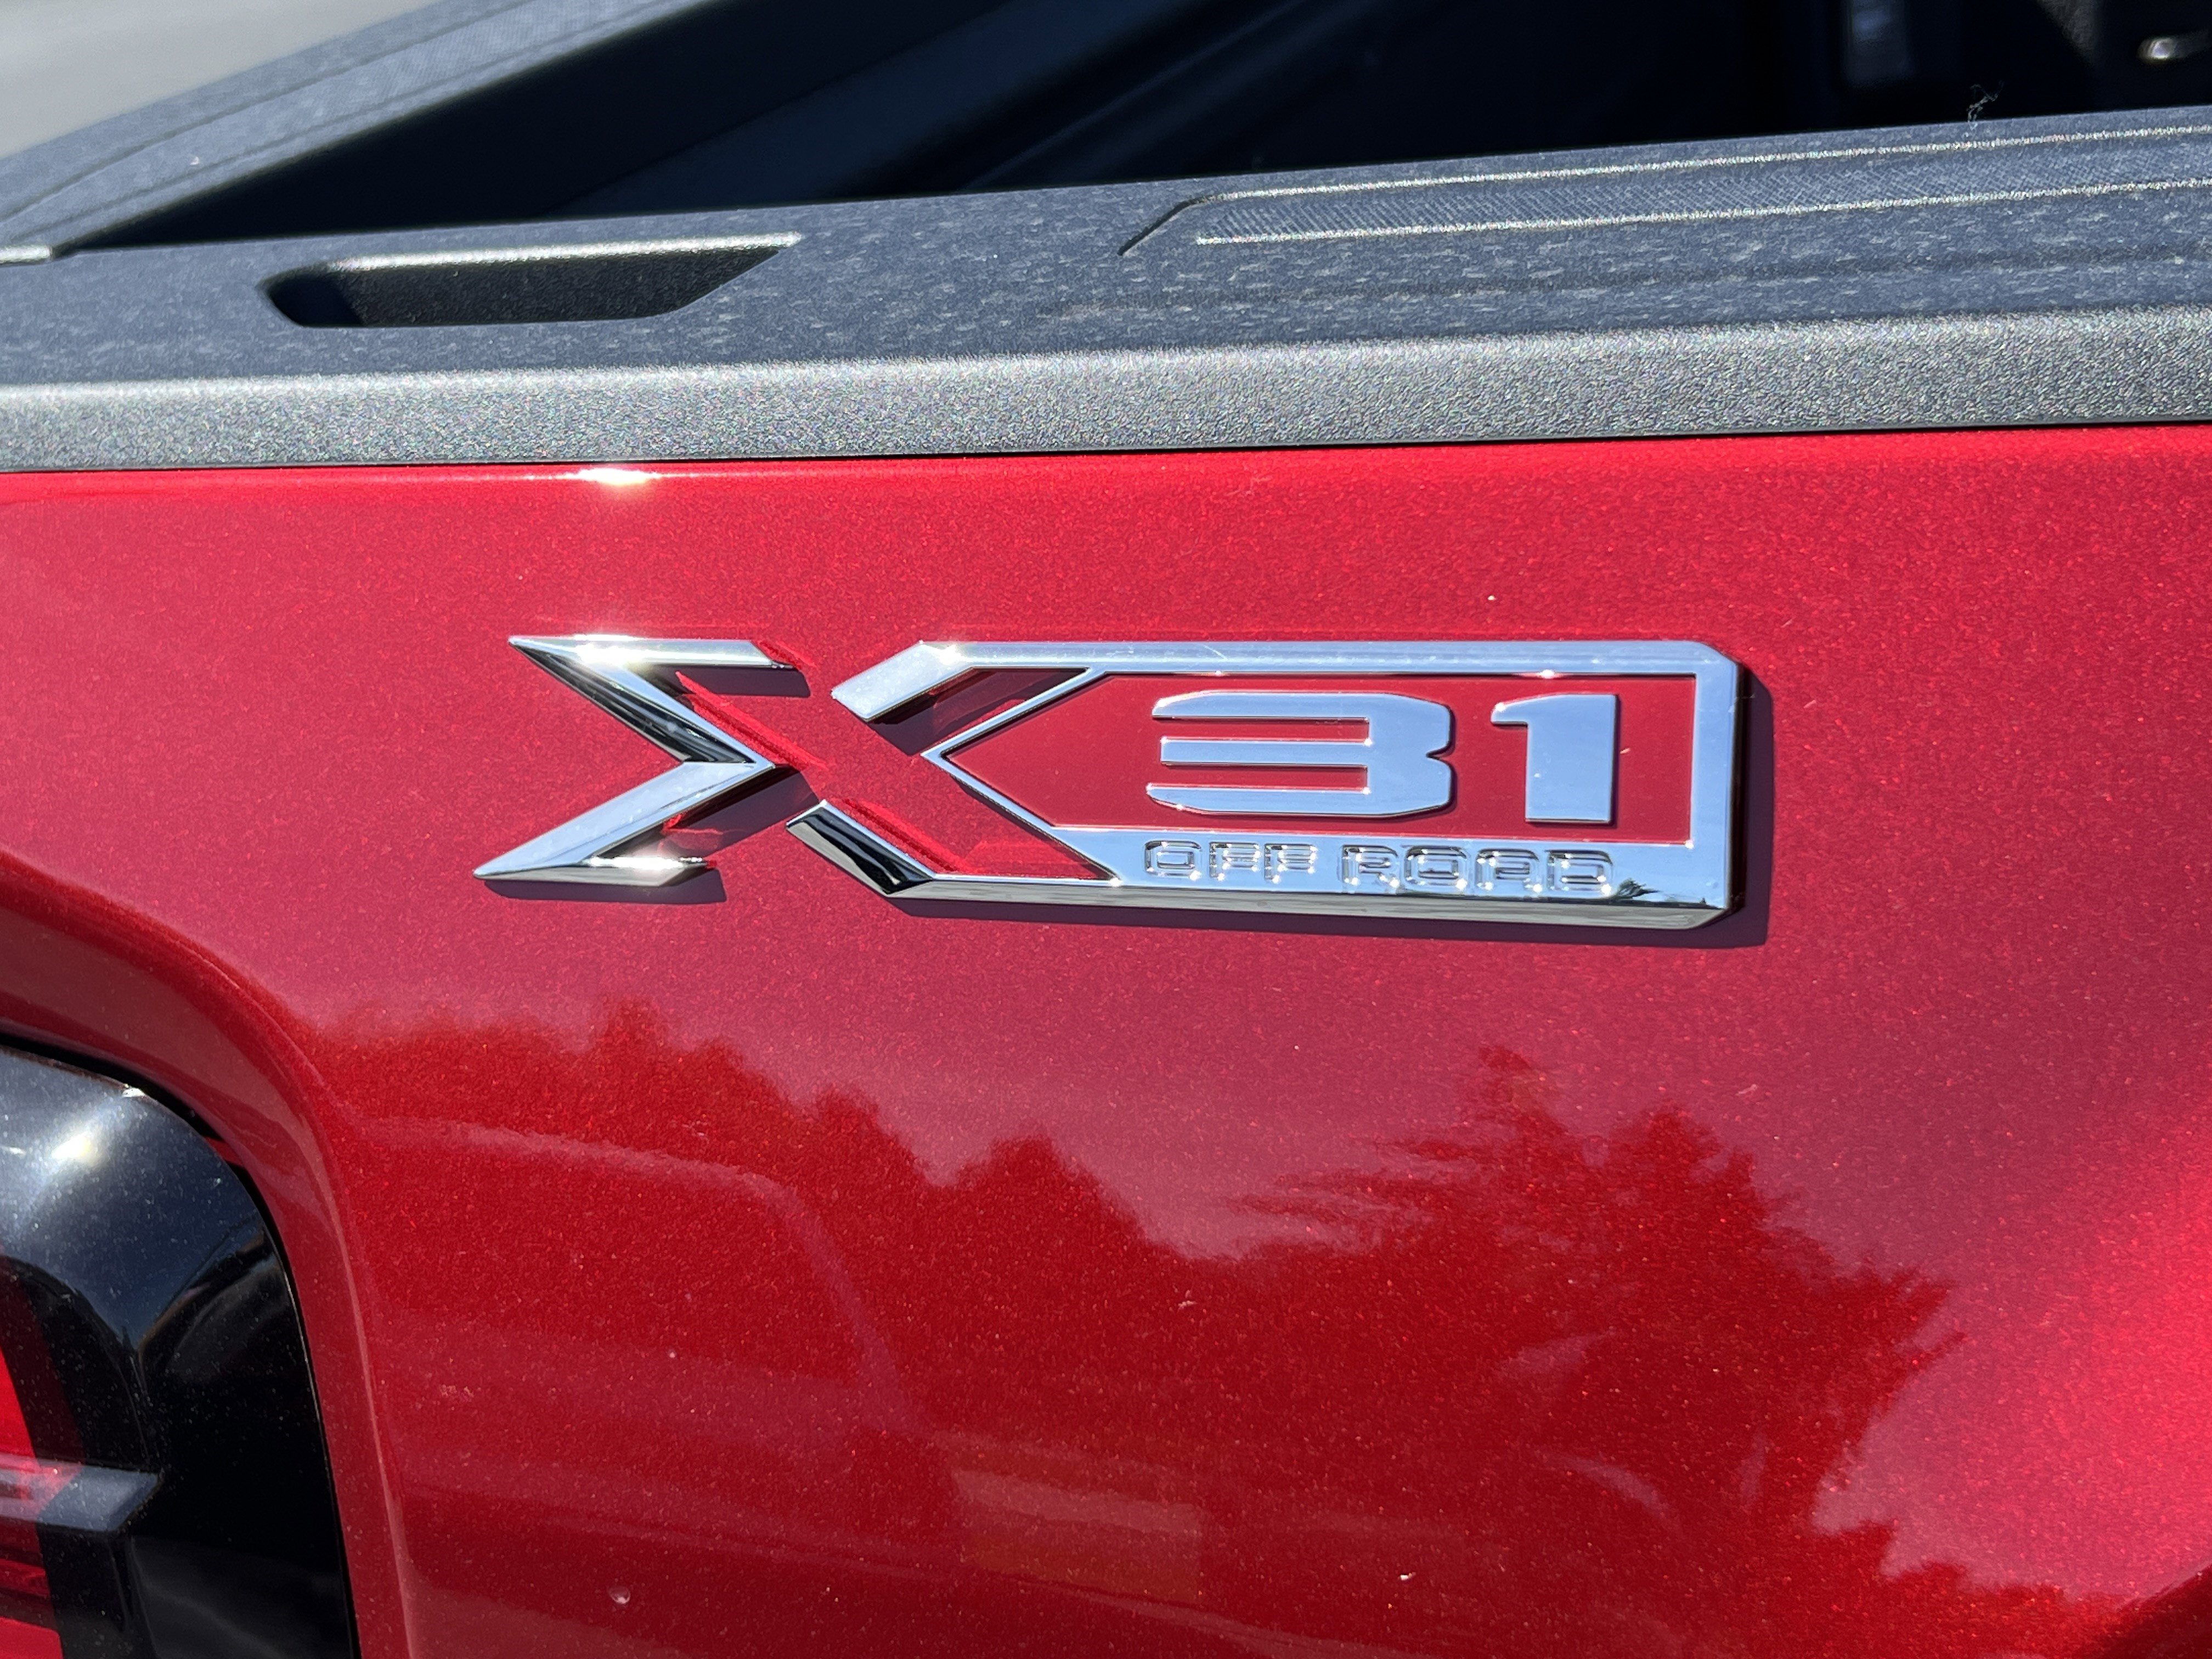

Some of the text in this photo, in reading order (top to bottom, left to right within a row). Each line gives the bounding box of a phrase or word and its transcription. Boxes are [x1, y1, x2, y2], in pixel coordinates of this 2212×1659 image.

[475, 635, 1617, 900] X31
[1144, 840, 1613, 898] OFF ROAD
